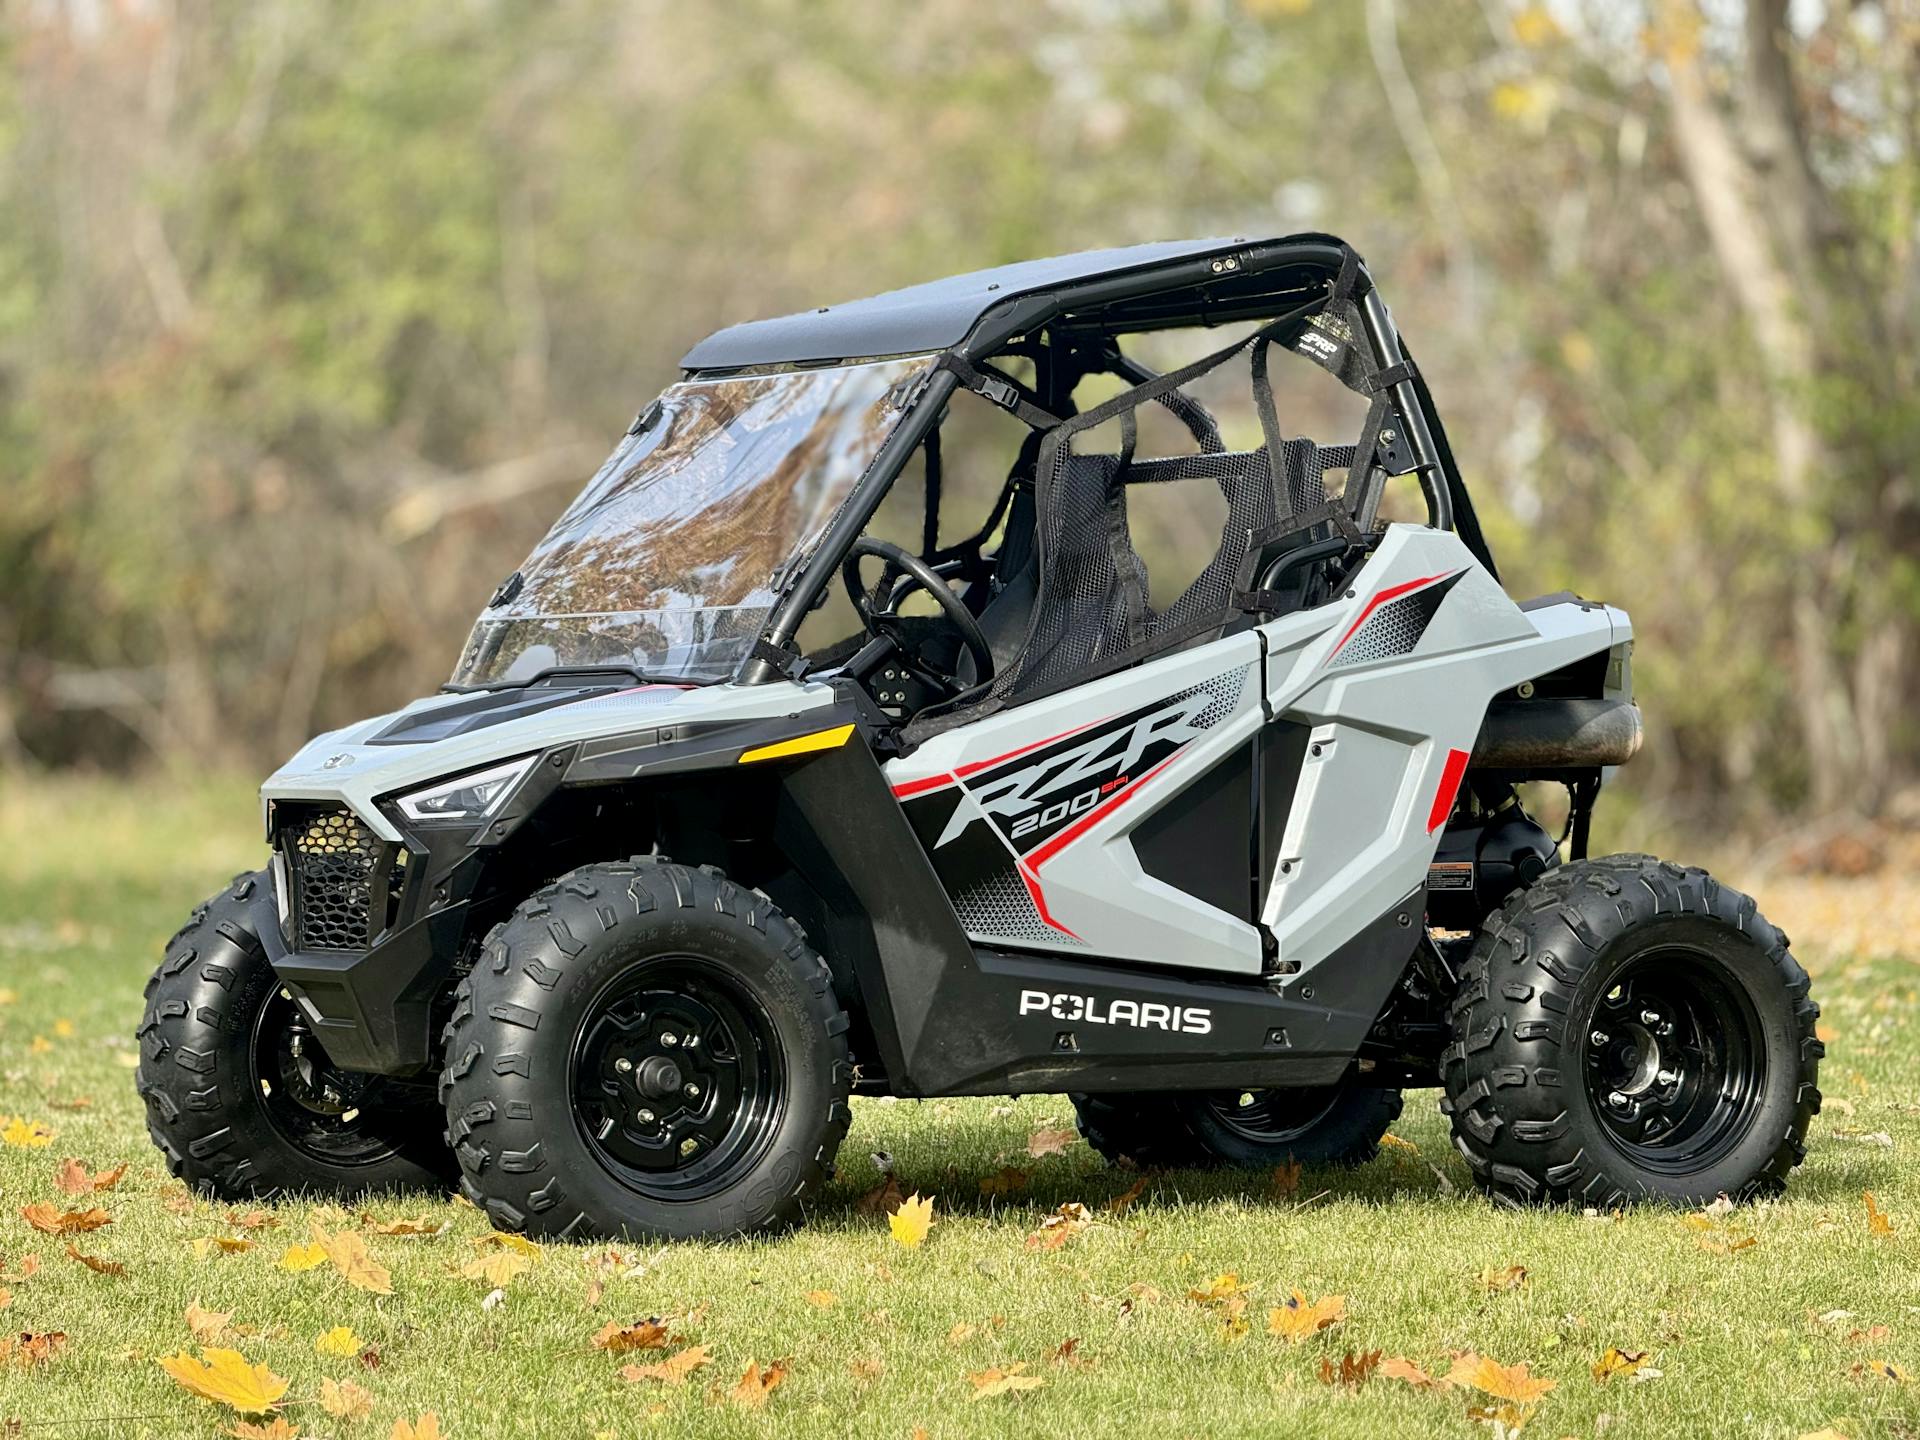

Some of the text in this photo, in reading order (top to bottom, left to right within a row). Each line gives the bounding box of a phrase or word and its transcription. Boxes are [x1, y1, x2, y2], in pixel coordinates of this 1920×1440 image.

[1300, 332, 1338, 352] PRP
[932, 693, 1216, 850] RZR
[1010, 787, 1100, 840] 200
[1019, 990, 1212, 1034] POLARIS
